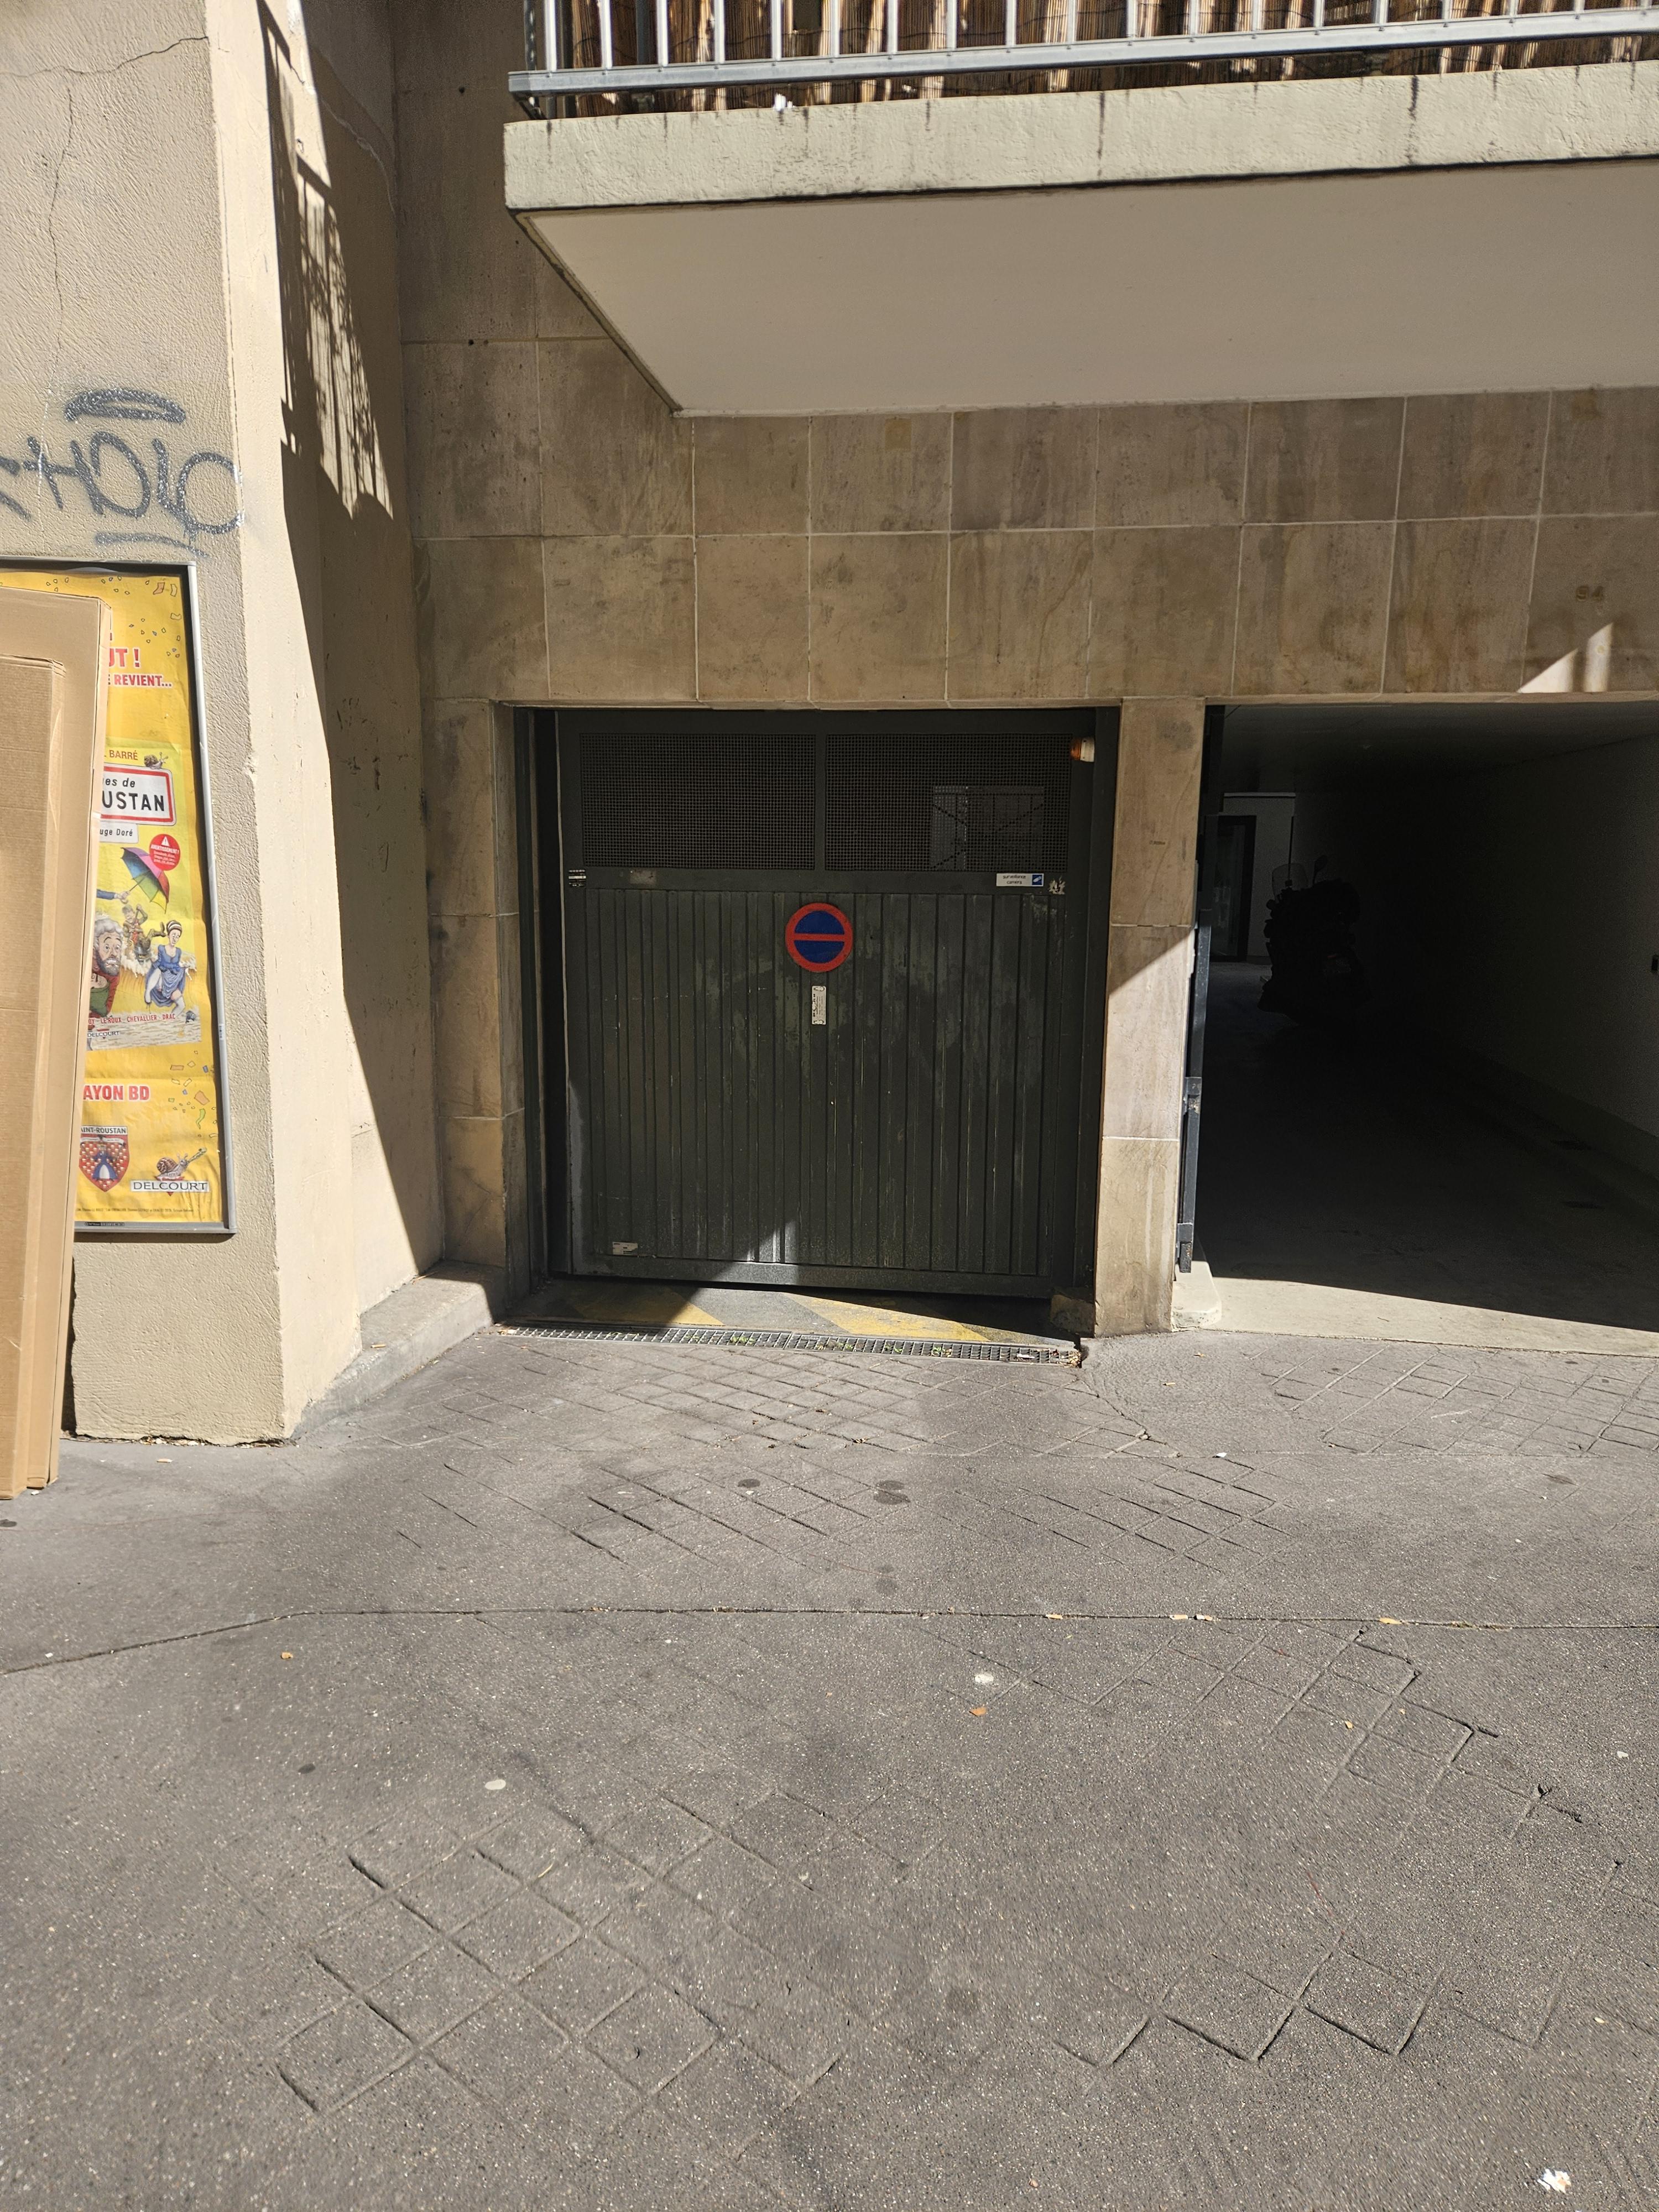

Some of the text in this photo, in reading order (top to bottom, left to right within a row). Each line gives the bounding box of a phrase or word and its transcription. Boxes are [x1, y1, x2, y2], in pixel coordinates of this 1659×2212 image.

[109, 750, 138, 760] BARRÉ
[103, 778, 135, 787] es de
[128, 1086, 149, 1100] BD
[133, 1182, 207, 1190] DELCOURT
